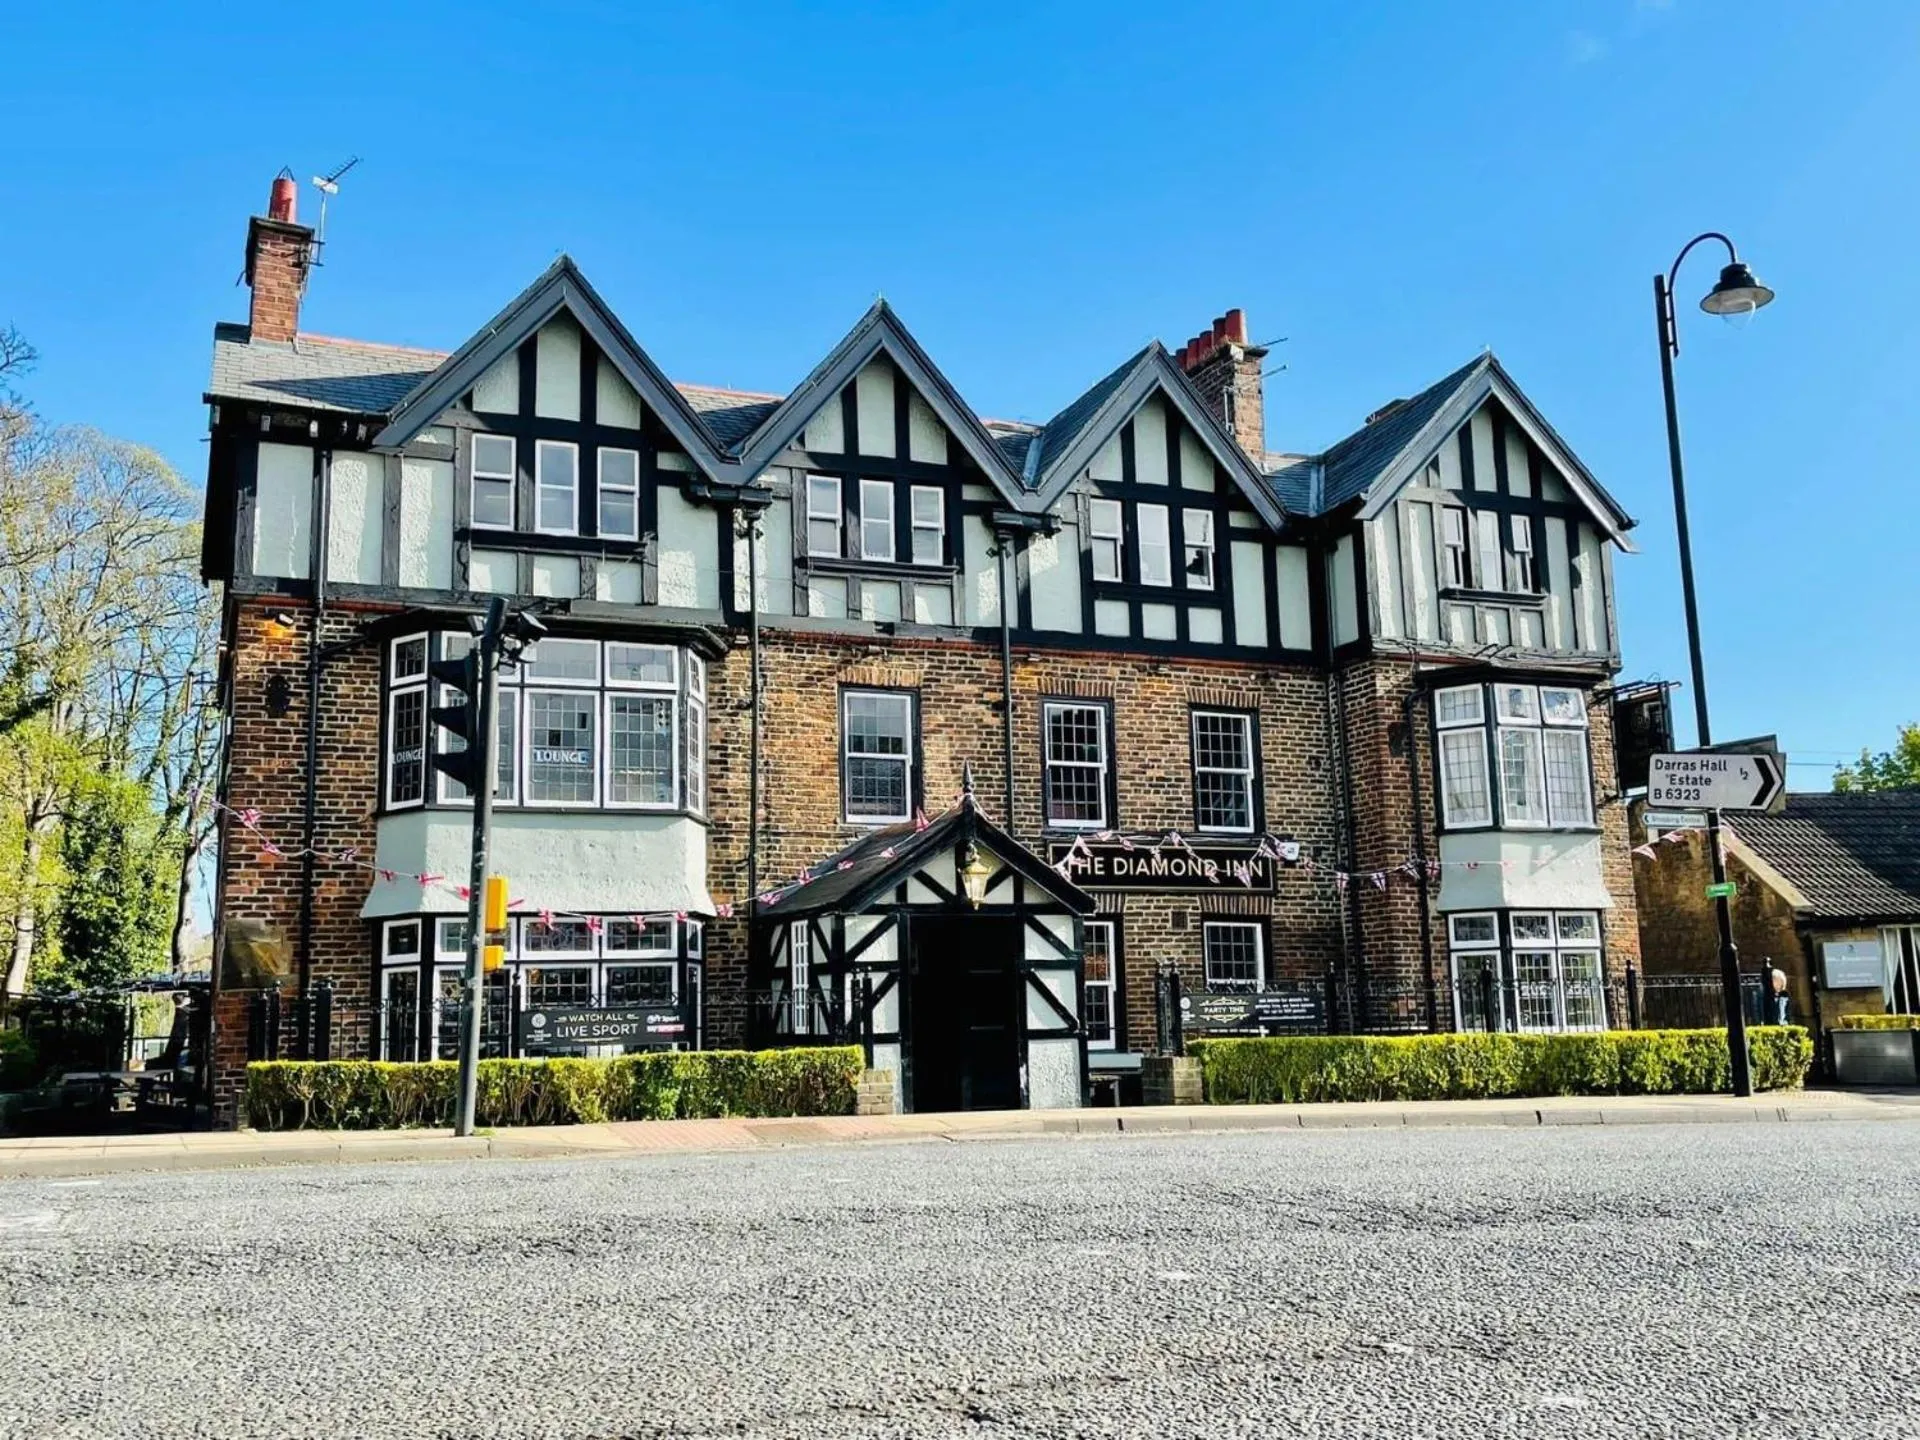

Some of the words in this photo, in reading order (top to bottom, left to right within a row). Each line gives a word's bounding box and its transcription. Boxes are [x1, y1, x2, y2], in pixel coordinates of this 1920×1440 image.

[536, 750, 588, 764] LOUNGE
[1655, 759, 1696, 771] Darras
[1700, 760, 1727, 771] Hall
[1669, 774, 1712, 786] Estate
[1654, 788, 1662, 800] B
[1666, 789, 1700, 800] 6323
[1113, 857, 1218, 877] DIAMOND
[1226, 859, 1263, 877] INN
[569, 1014, 602, 1023] WATCH
[605, 1013, 623, 1021] ALL
[556, 1025, 588, 1038] LIVE
[592, 1024, 638, 1036] SPORT
